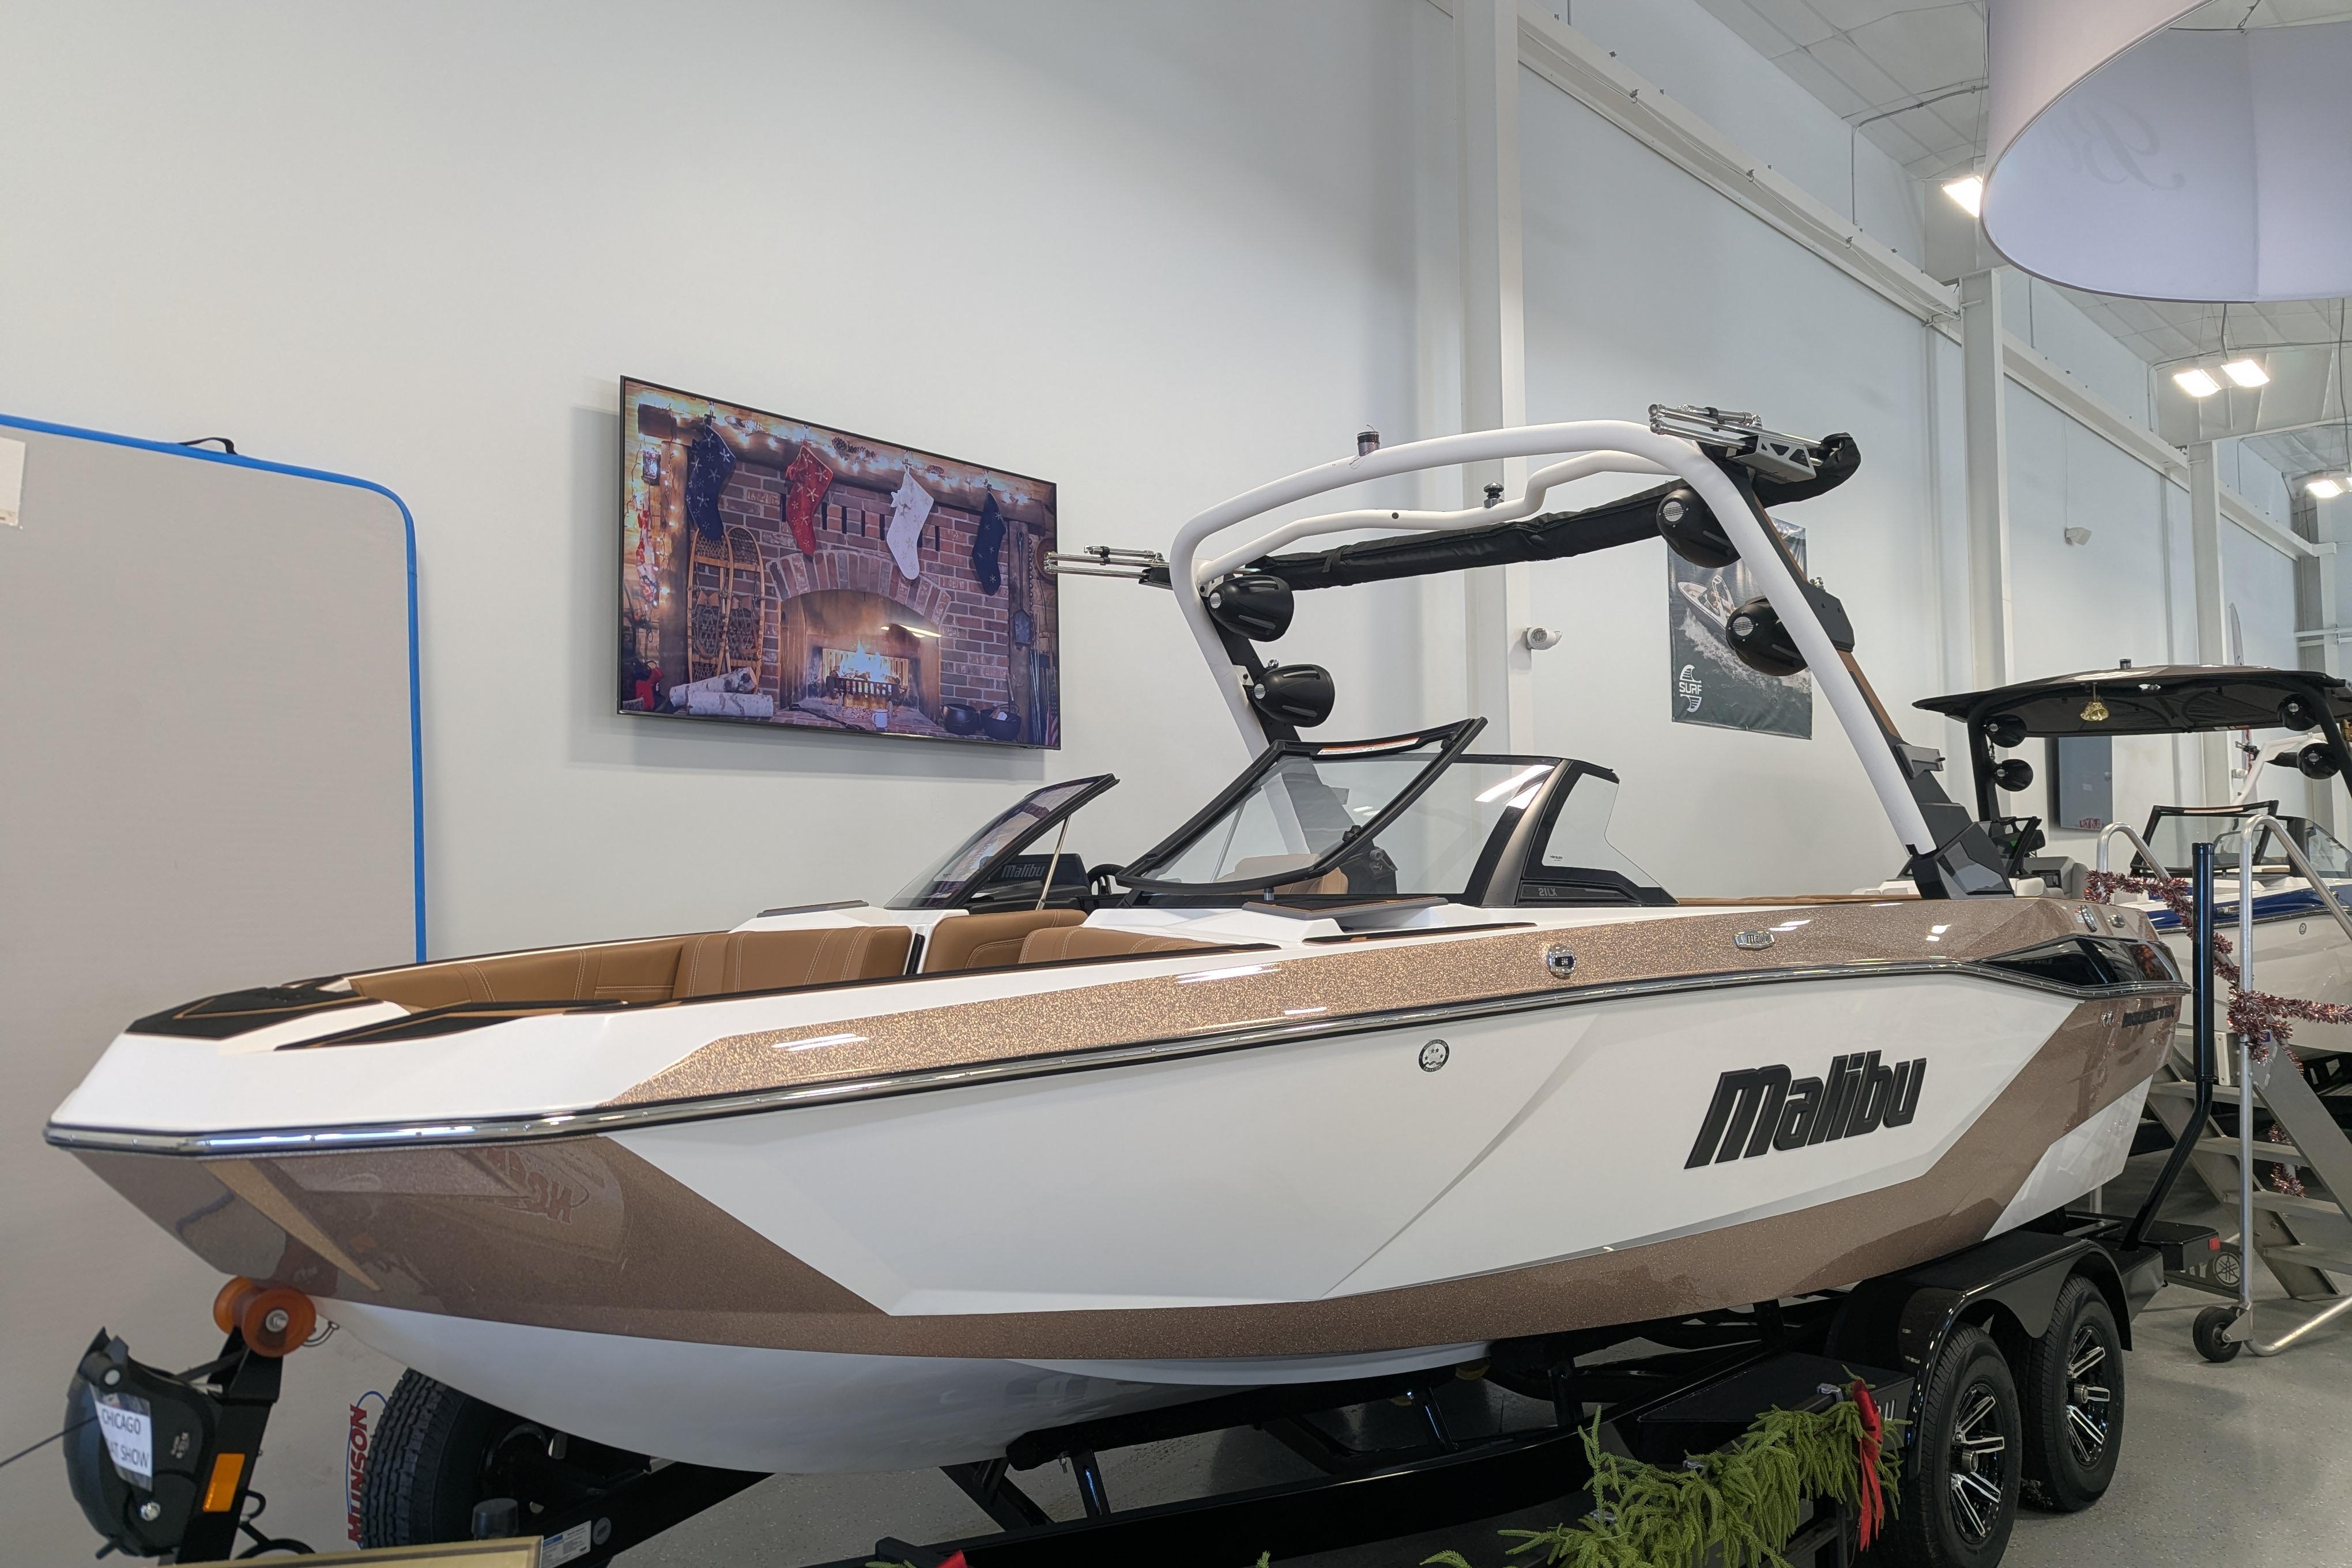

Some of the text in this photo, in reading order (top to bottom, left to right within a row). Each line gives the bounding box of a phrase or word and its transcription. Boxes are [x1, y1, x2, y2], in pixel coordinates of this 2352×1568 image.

[1679, 682, 1702, 695] SURF
[1001, 864, 1046, 878] Malibu
[1538, 887, 1558, 896] 21LX
[1746, 933, 1772, 944] Malibu
[1683, 1050, 1927, 1170] Malibu
[101, 1408, 141, 1435] CHICAGO
[120, 1444, 150, 1469] SHOW
